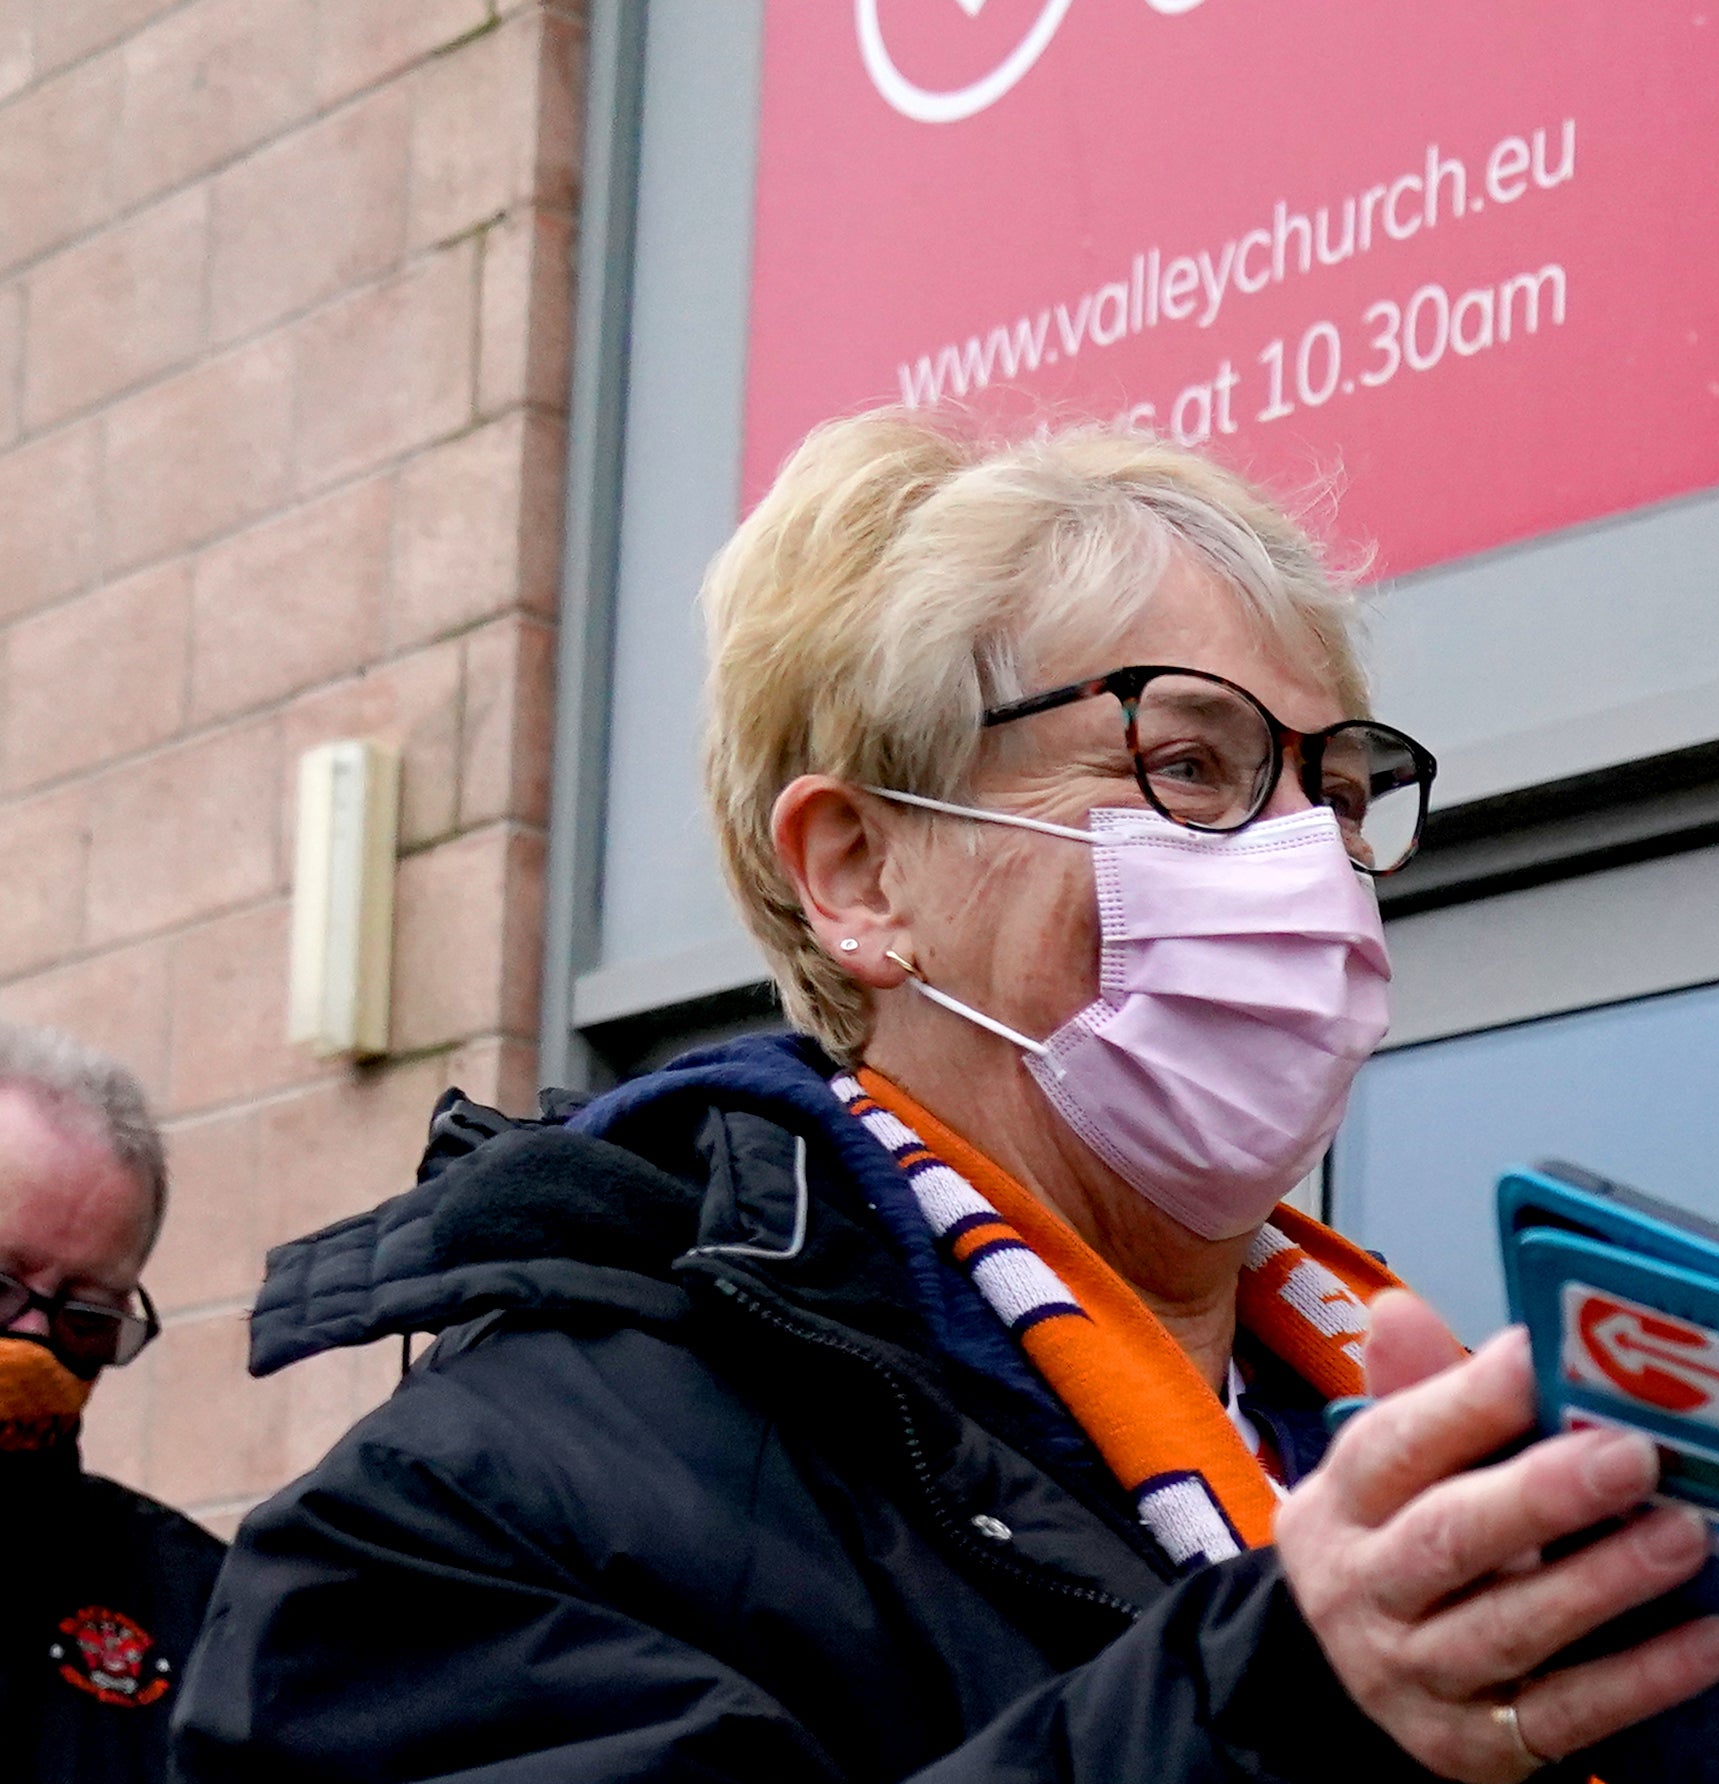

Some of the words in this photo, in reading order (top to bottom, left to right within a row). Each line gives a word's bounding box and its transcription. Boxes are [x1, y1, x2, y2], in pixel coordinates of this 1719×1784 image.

[898, 118, 1575, 409] www.valleychurch.eu
[1171, 360, 1240, 448] at
[1256, 263, 1566, 422] 10.30am
